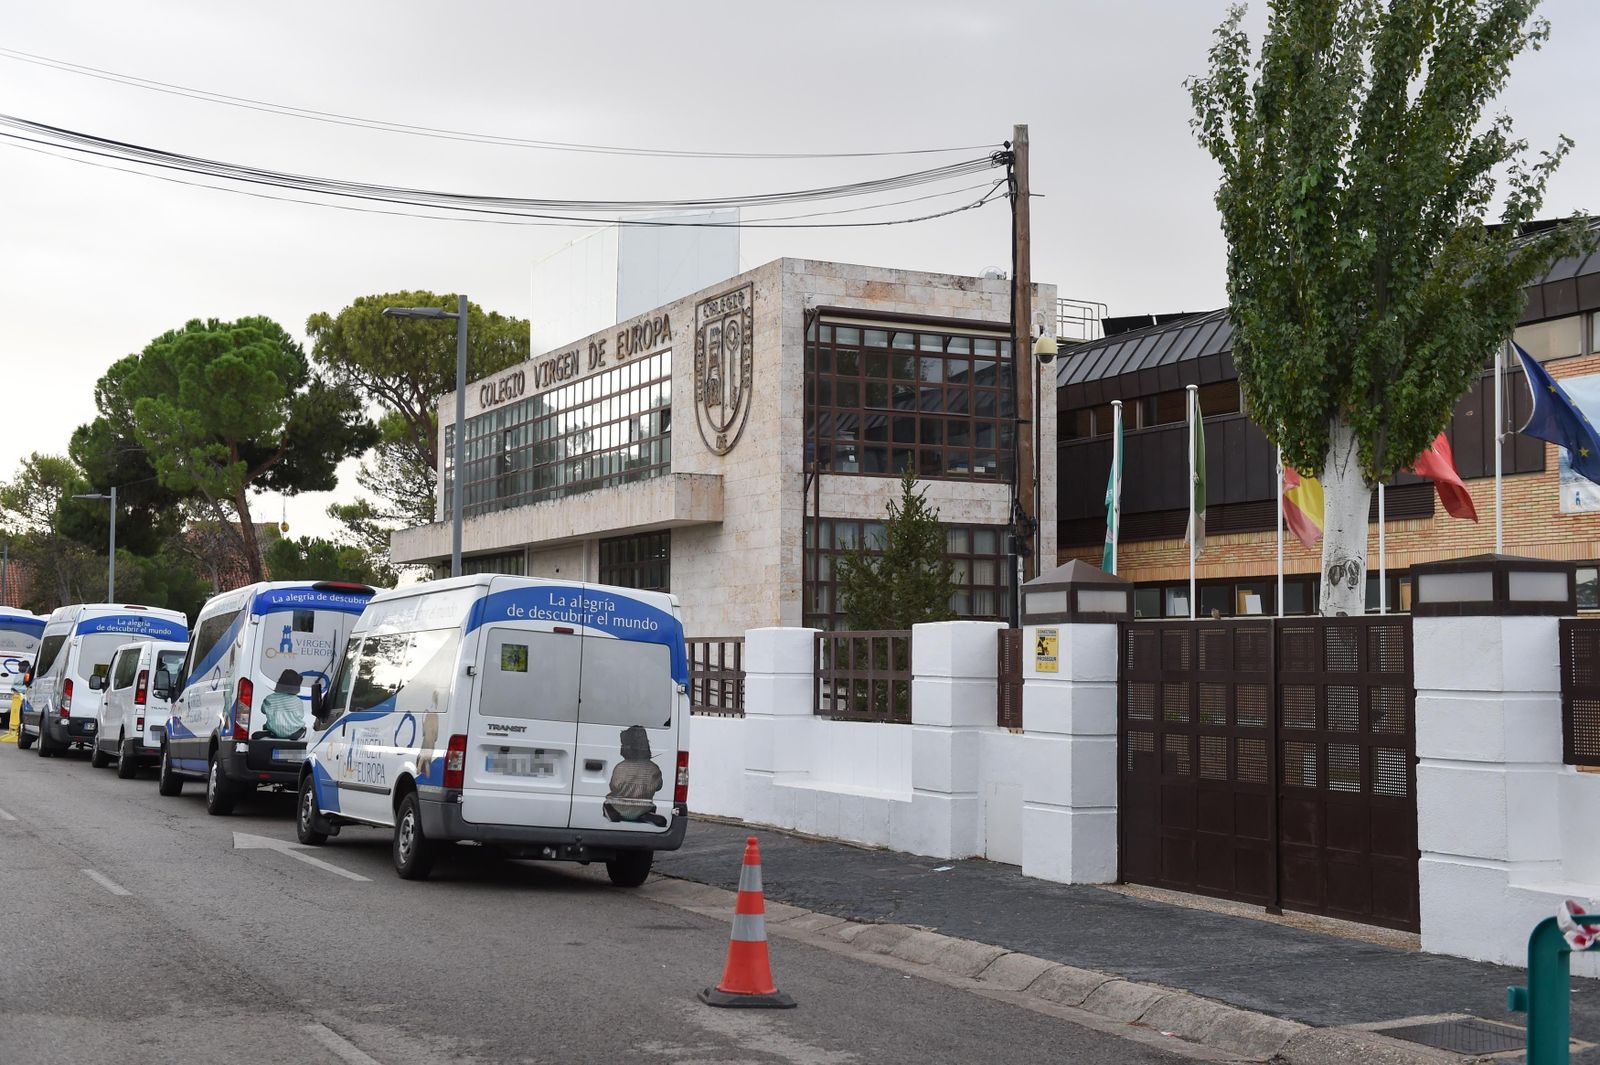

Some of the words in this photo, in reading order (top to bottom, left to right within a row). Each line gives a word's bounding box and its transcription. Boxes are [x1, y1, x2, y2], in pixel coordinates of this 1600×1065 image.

[479, 370, 525, 409] COLEGIO
[534, 348, 580, 389] VIRGEN
[588, 338, 607, 371] DE
[616, 313, 672, 360] EUROPA
[272, 596, 283, 604] La
[286, 593, 315, 603] alegría
[317, 593, 327, 601] de
[550, 593, 565, 606] La
[570, 595, 615, 613] alegría
[117, 618, 126, 626] La
[507, 604, 525, 617] de
[528, 606, 594, 624] descubrir
[597, 613, 608, 625] el
[613, 616, 658, 631] mundo
[107, 625, 138, 633] descubrir
[296, 638, 333, 649] VIRGEN
[300, 647, 337, 657] EUROPA
[487, 723, 528, 733] TRANSIT
[357, 761, 386, 784] EUROPA
